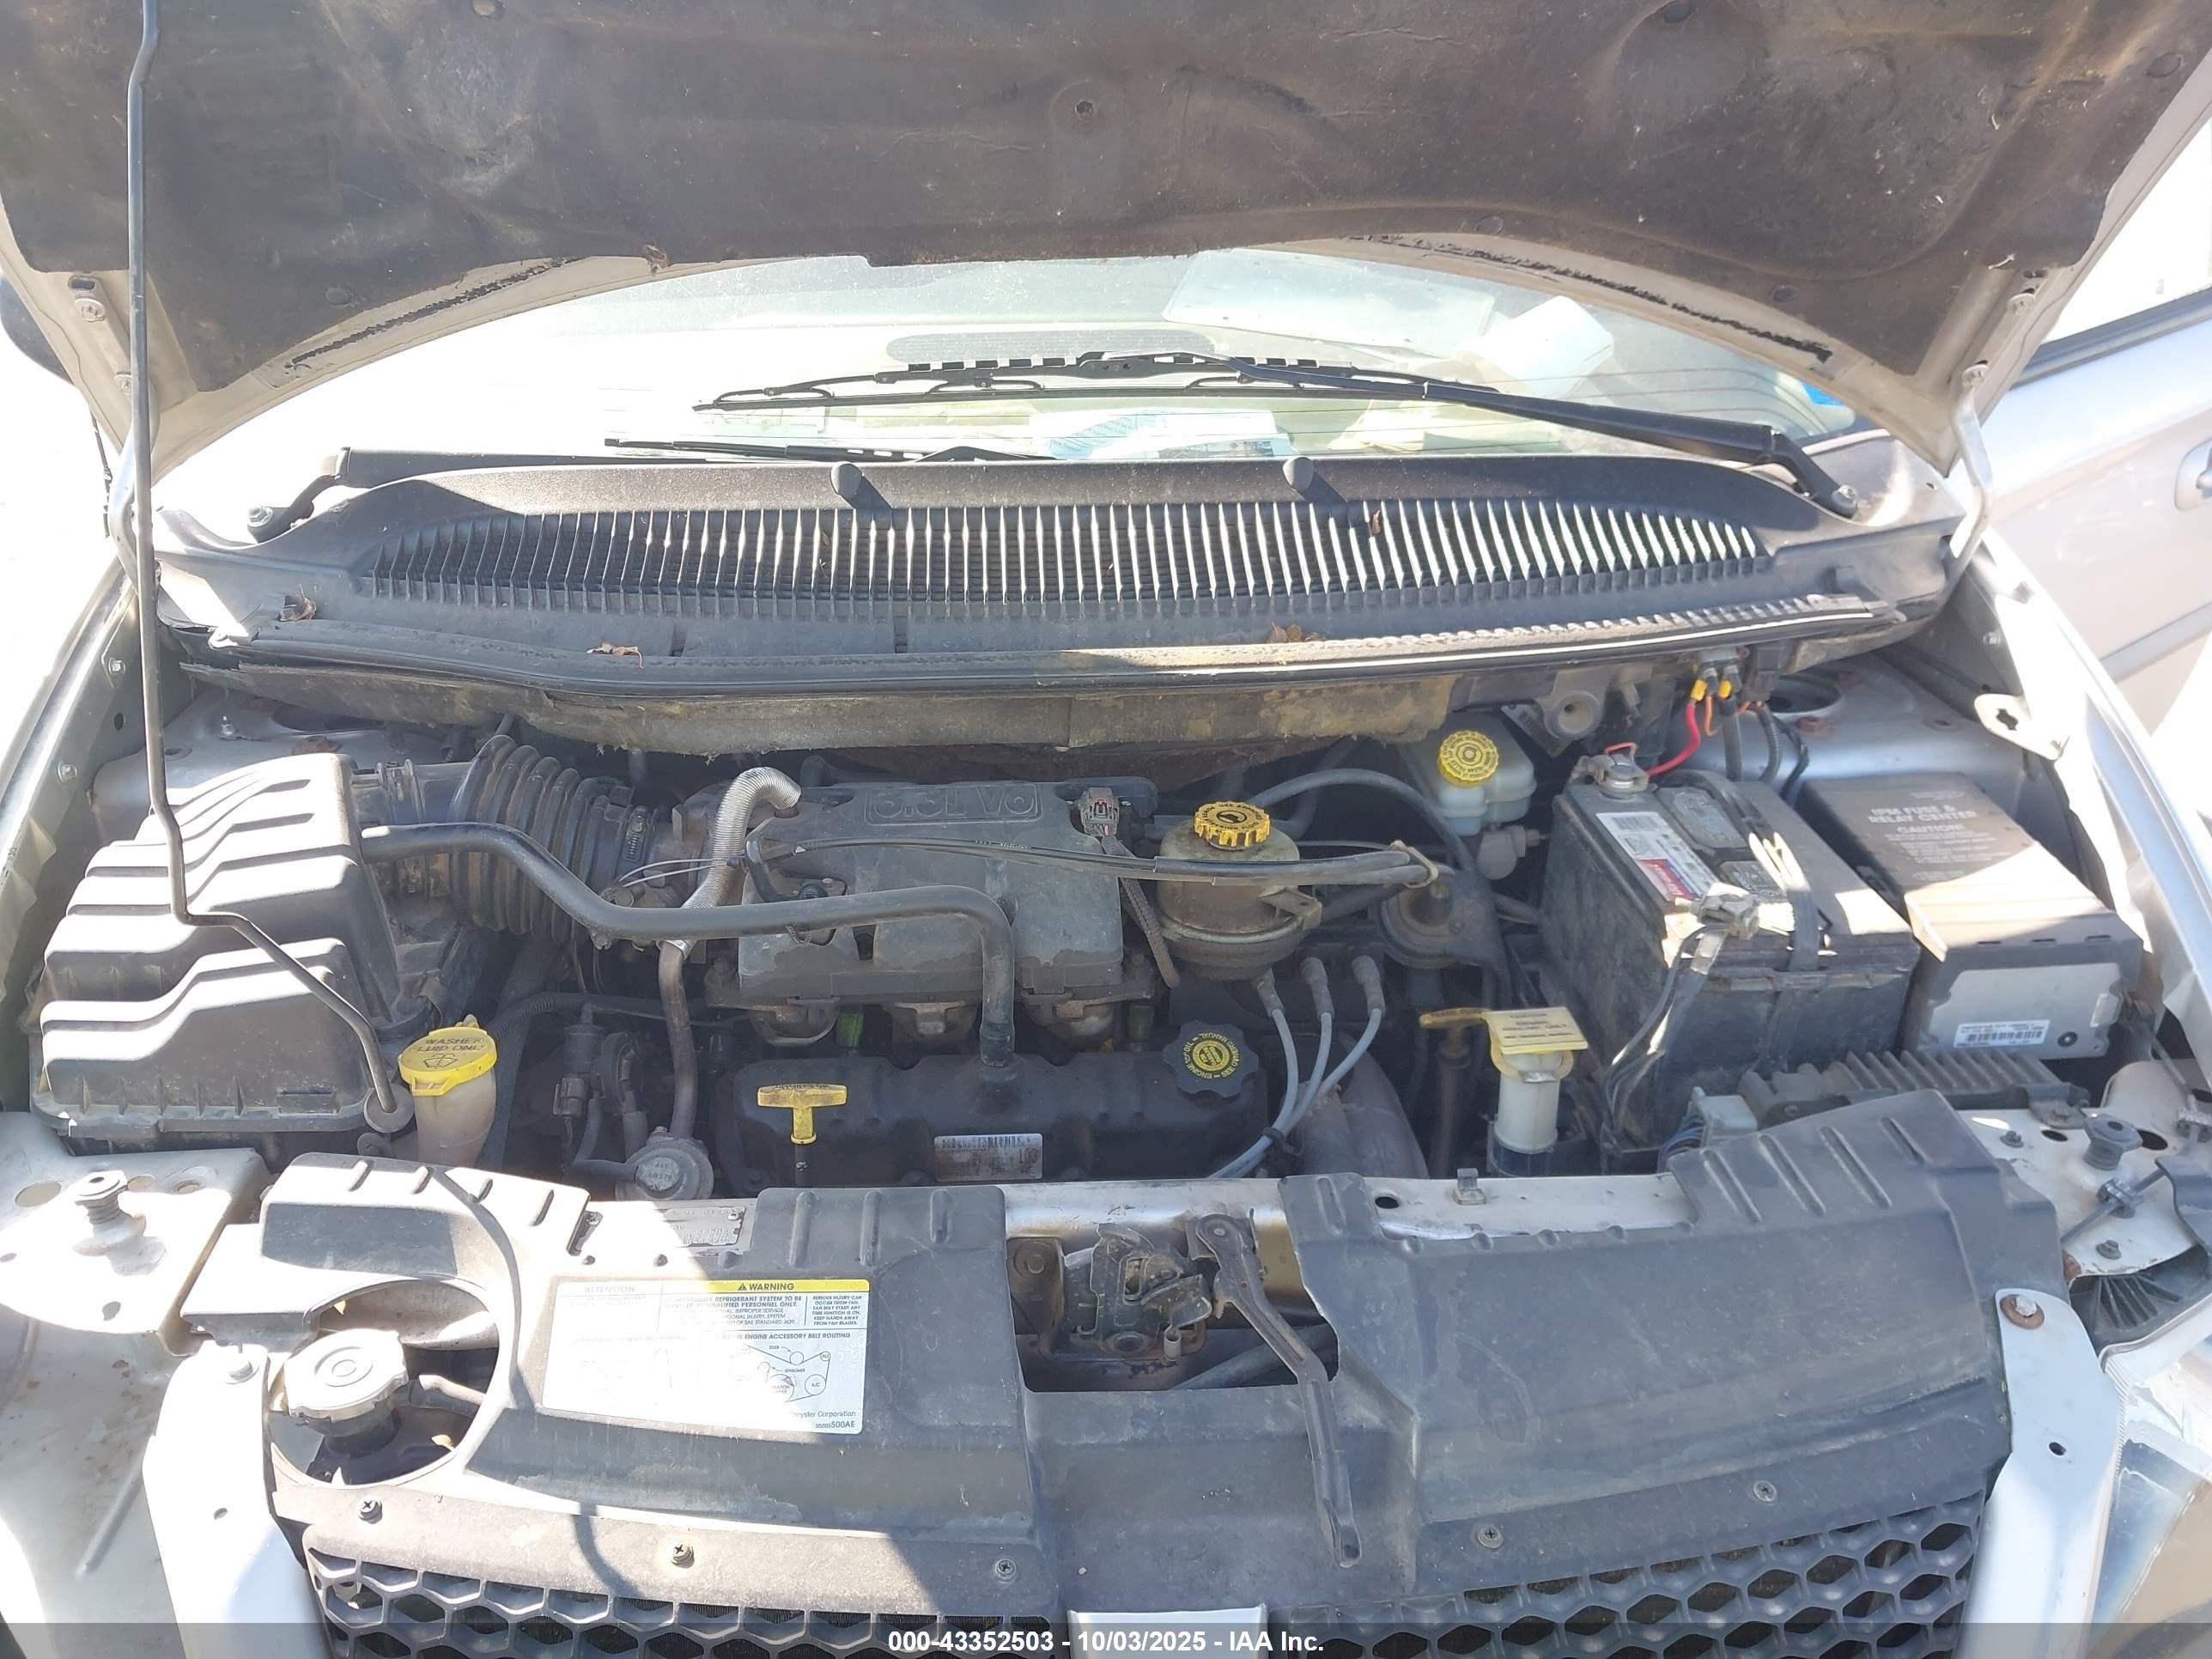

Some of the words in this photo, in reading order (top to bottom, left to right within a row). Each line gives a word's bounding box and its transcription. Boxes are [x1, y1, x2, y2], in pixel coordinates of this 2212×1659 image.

[975, 786, 1036, 815] V6
[1917, 811, 1978, 822] CENTER
[749, 1282, 794, 1291] WARNING
